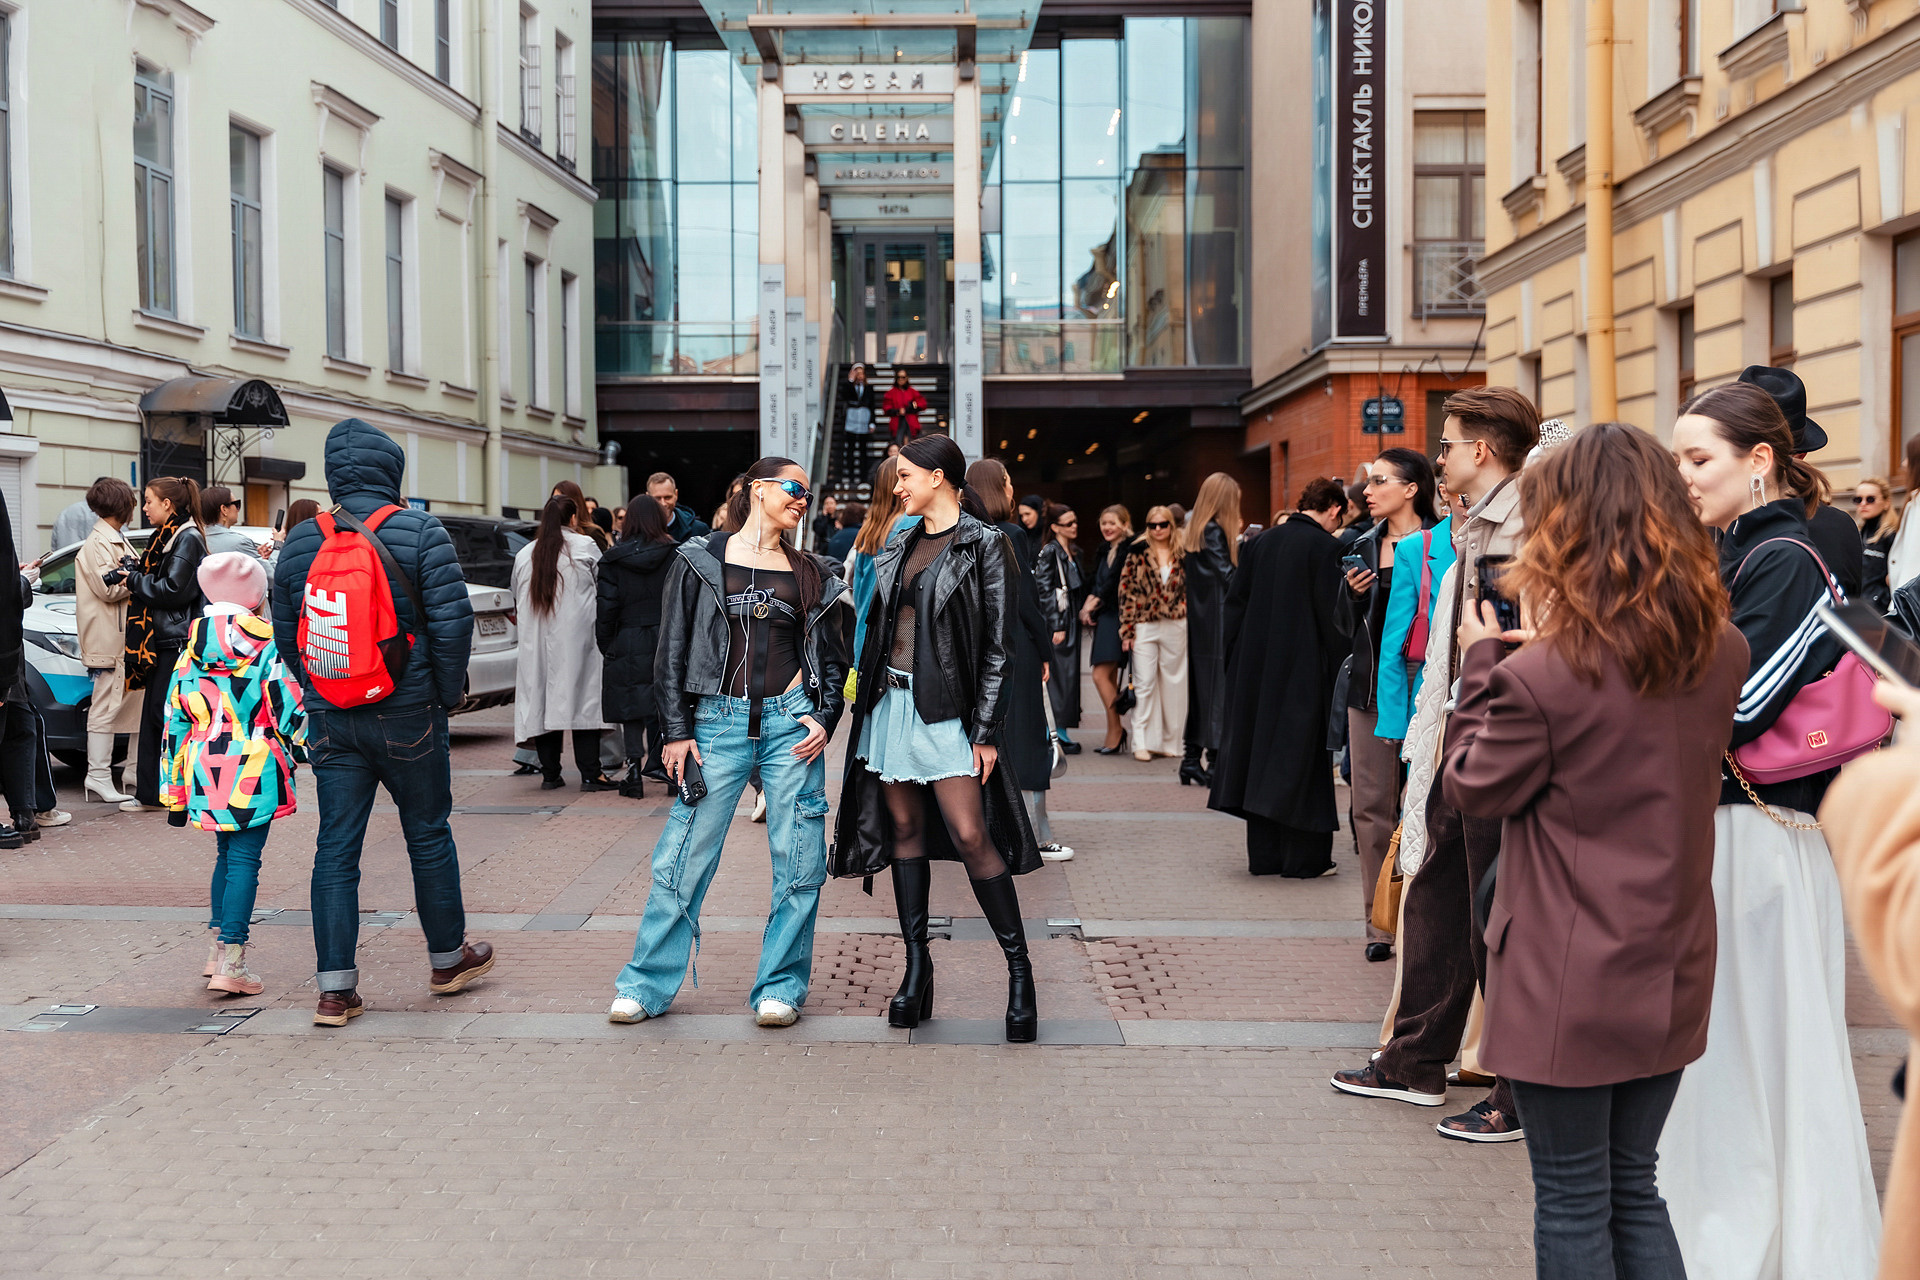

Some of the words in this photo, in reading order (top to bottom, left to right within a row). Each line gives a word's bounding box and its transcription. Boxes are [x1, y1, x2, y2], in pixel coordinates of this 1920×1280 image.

[813, 71, 924, 90] НОВАЯ
[830, 123, 930, 142] СЦЕНА
[1352, 83, 1373, 229] СПЕКТАКЛЬ
[1358, 257, 1369, 316] ПРЕМЬЕРА
[305, 583, 350, 679] NIKE
